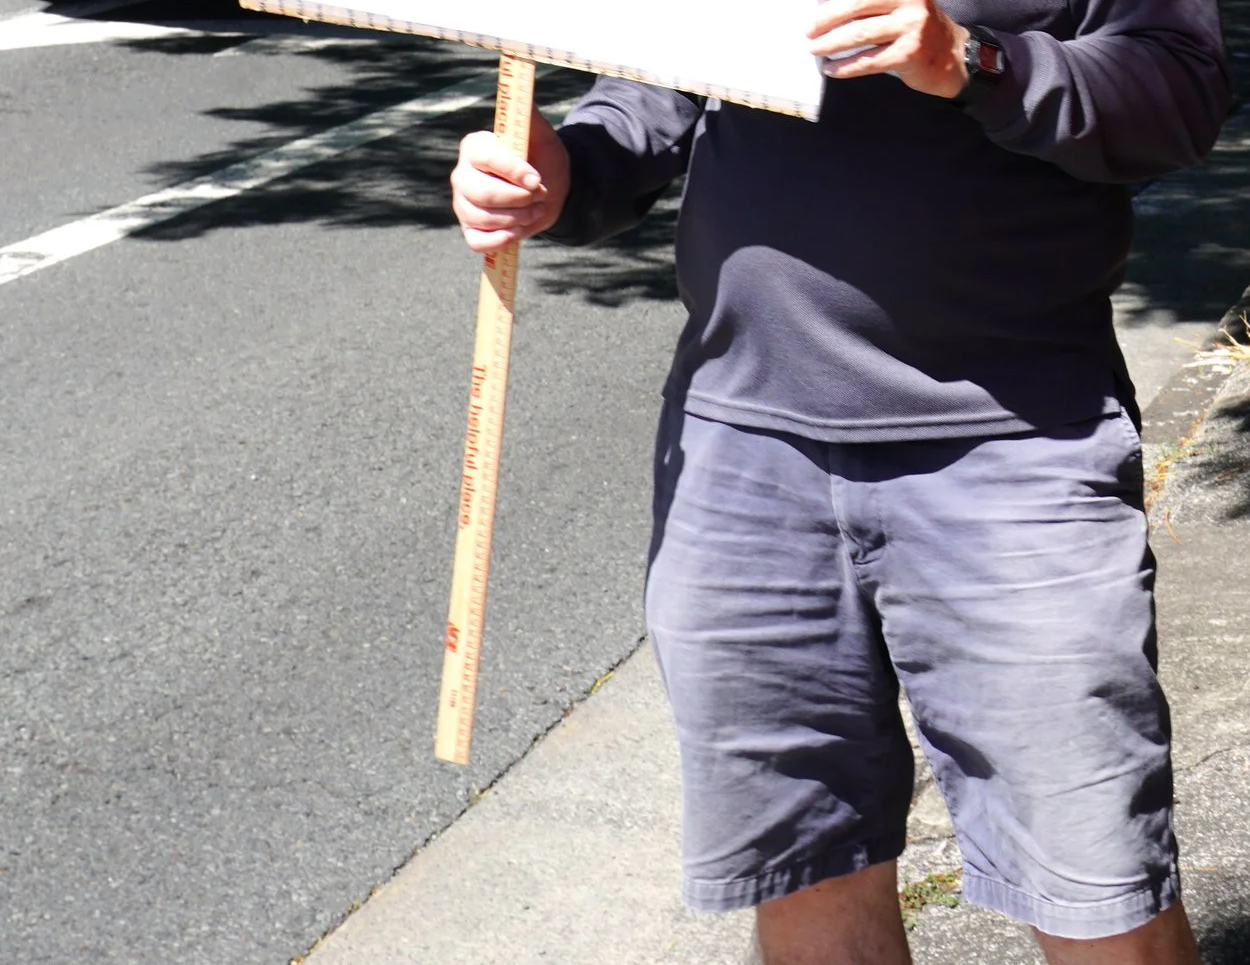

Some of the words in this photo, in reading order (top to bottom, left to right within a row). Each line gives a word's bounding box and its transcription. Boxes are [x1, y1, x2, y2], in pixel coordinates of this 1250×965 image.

[470, 365, 488, 399] The
[463, 404, 484, 470] helpful
[445, 620, 462, 654] ACE
